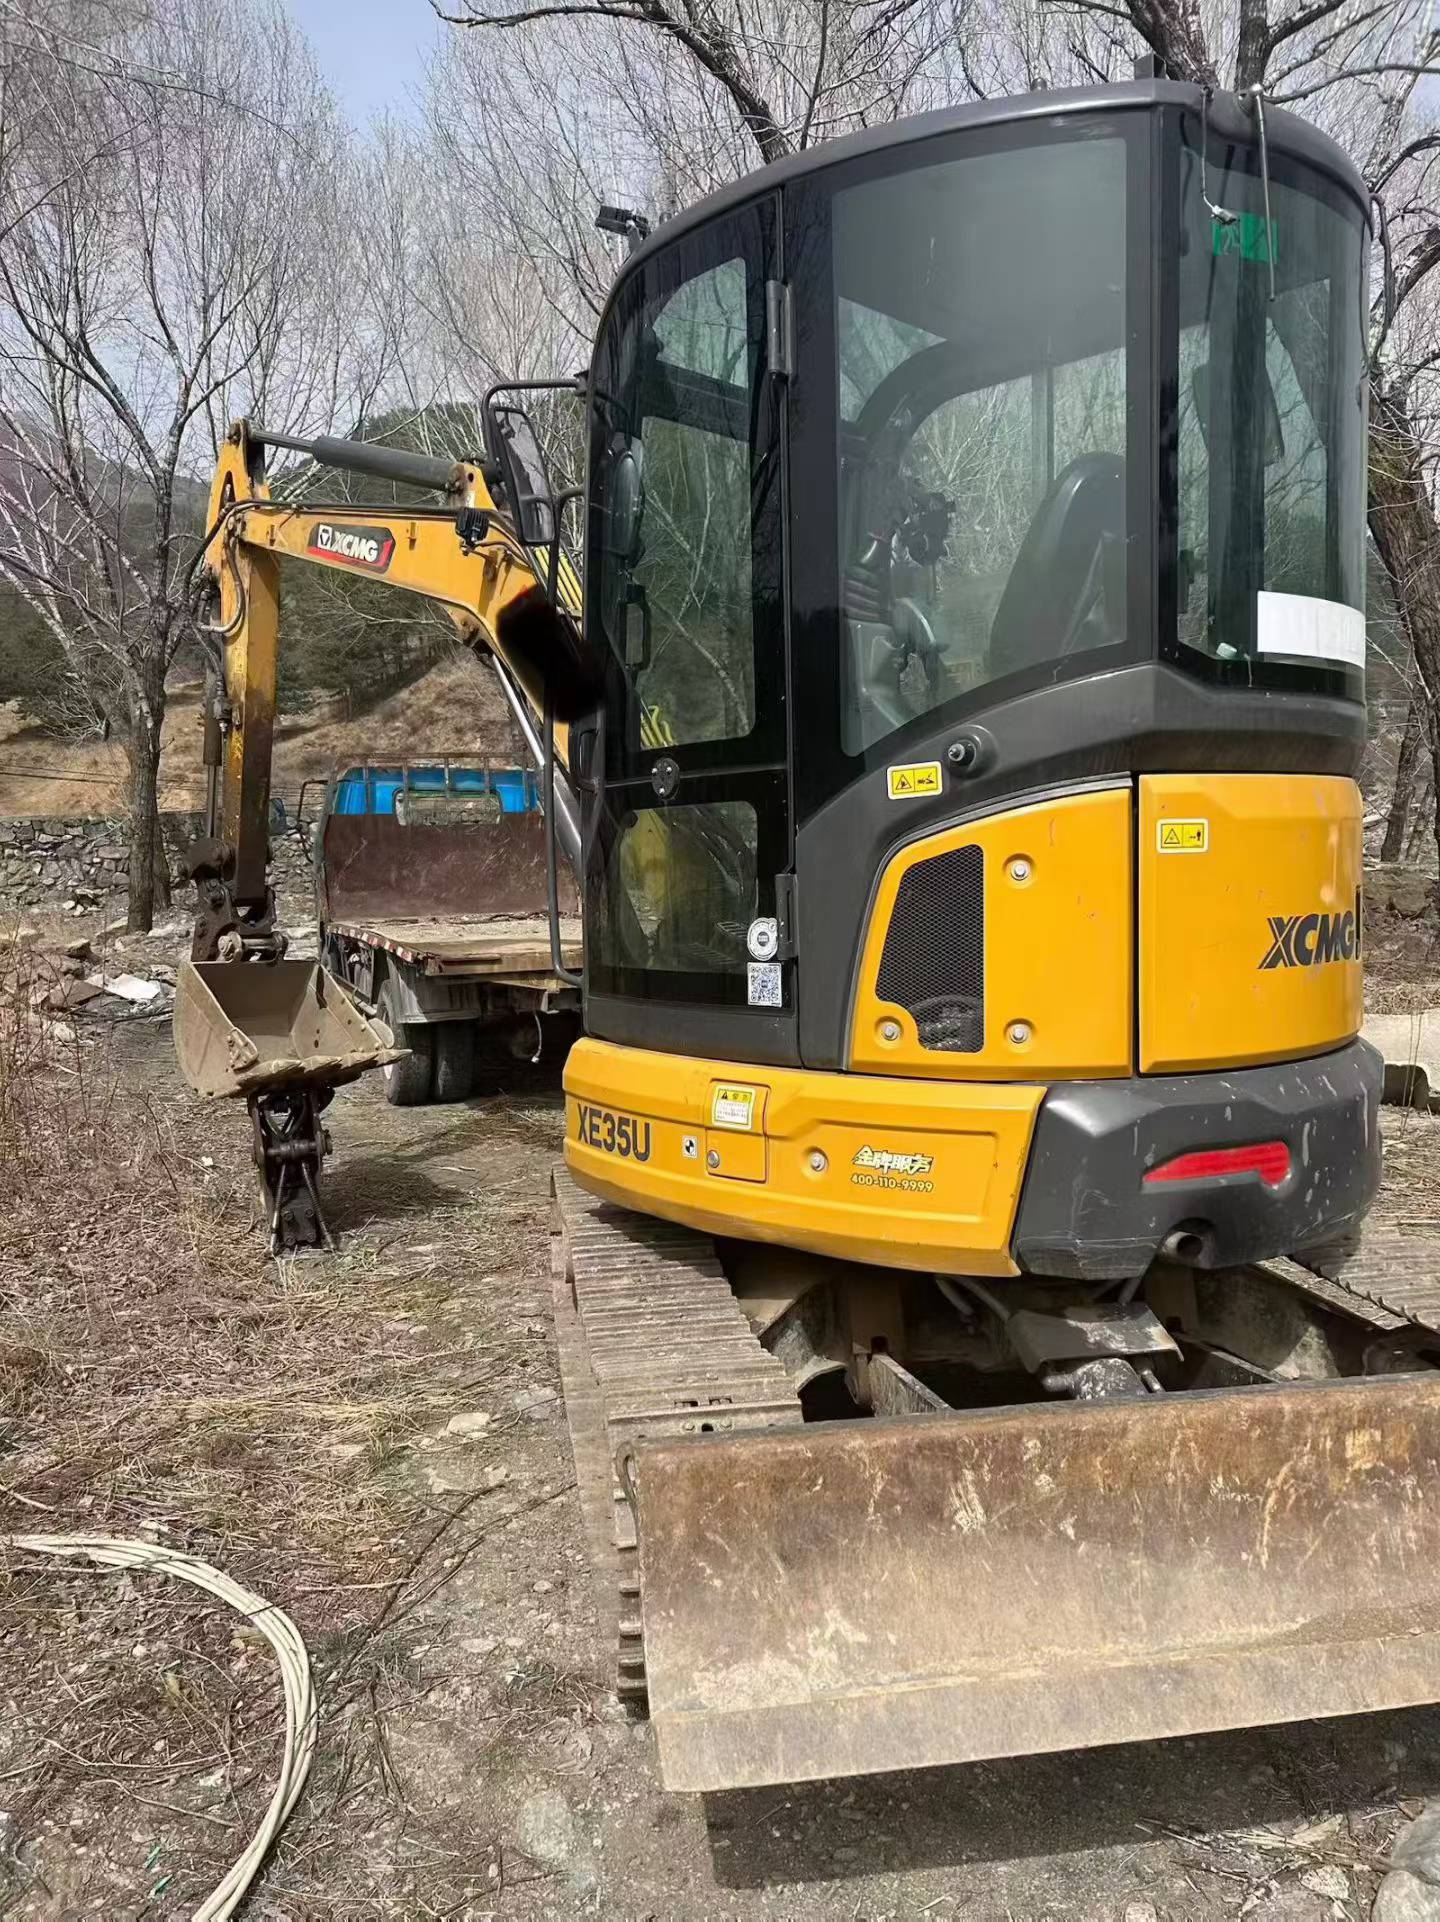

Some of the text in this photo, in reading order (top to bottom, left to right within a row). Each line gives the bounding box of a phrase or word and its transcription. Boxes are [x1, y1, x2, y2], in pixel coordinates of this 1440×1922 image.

[331, 530, 379, 563] XCMG
[577, 1103, 650, 1161] XE35U
[851, 1173, 934, 1192] 400-110-9999
